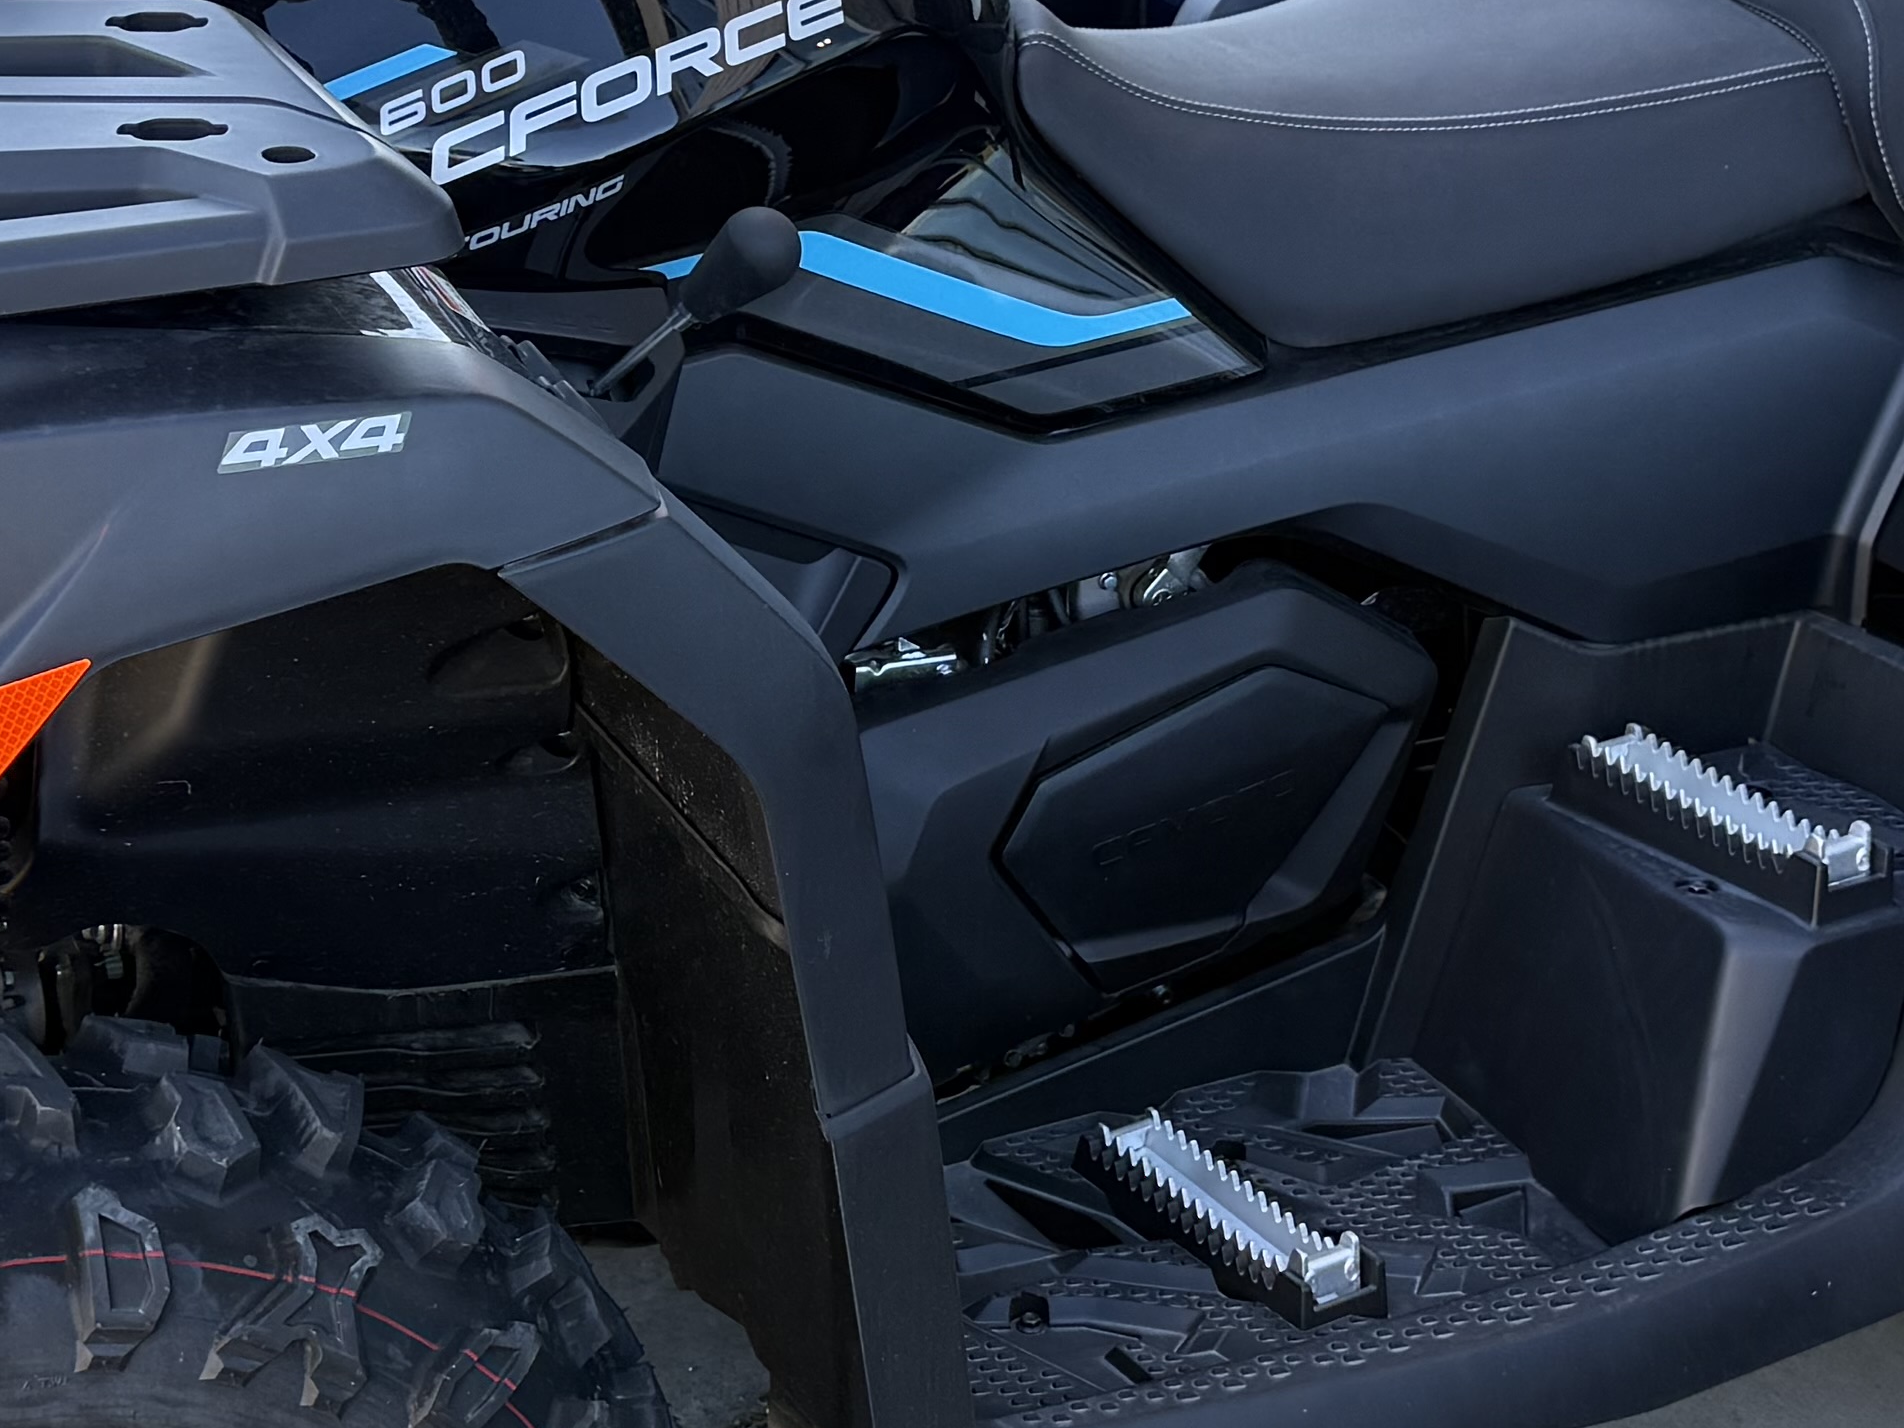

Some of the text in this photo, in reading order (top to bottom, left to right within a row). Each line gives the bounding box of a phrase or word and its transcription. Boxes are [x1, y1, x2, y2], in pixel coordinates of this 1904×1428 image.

[379, 49, 526, 136] 600
[464, 174, 625, 251] OURING
[220, 413, 406, 468] 4X4
